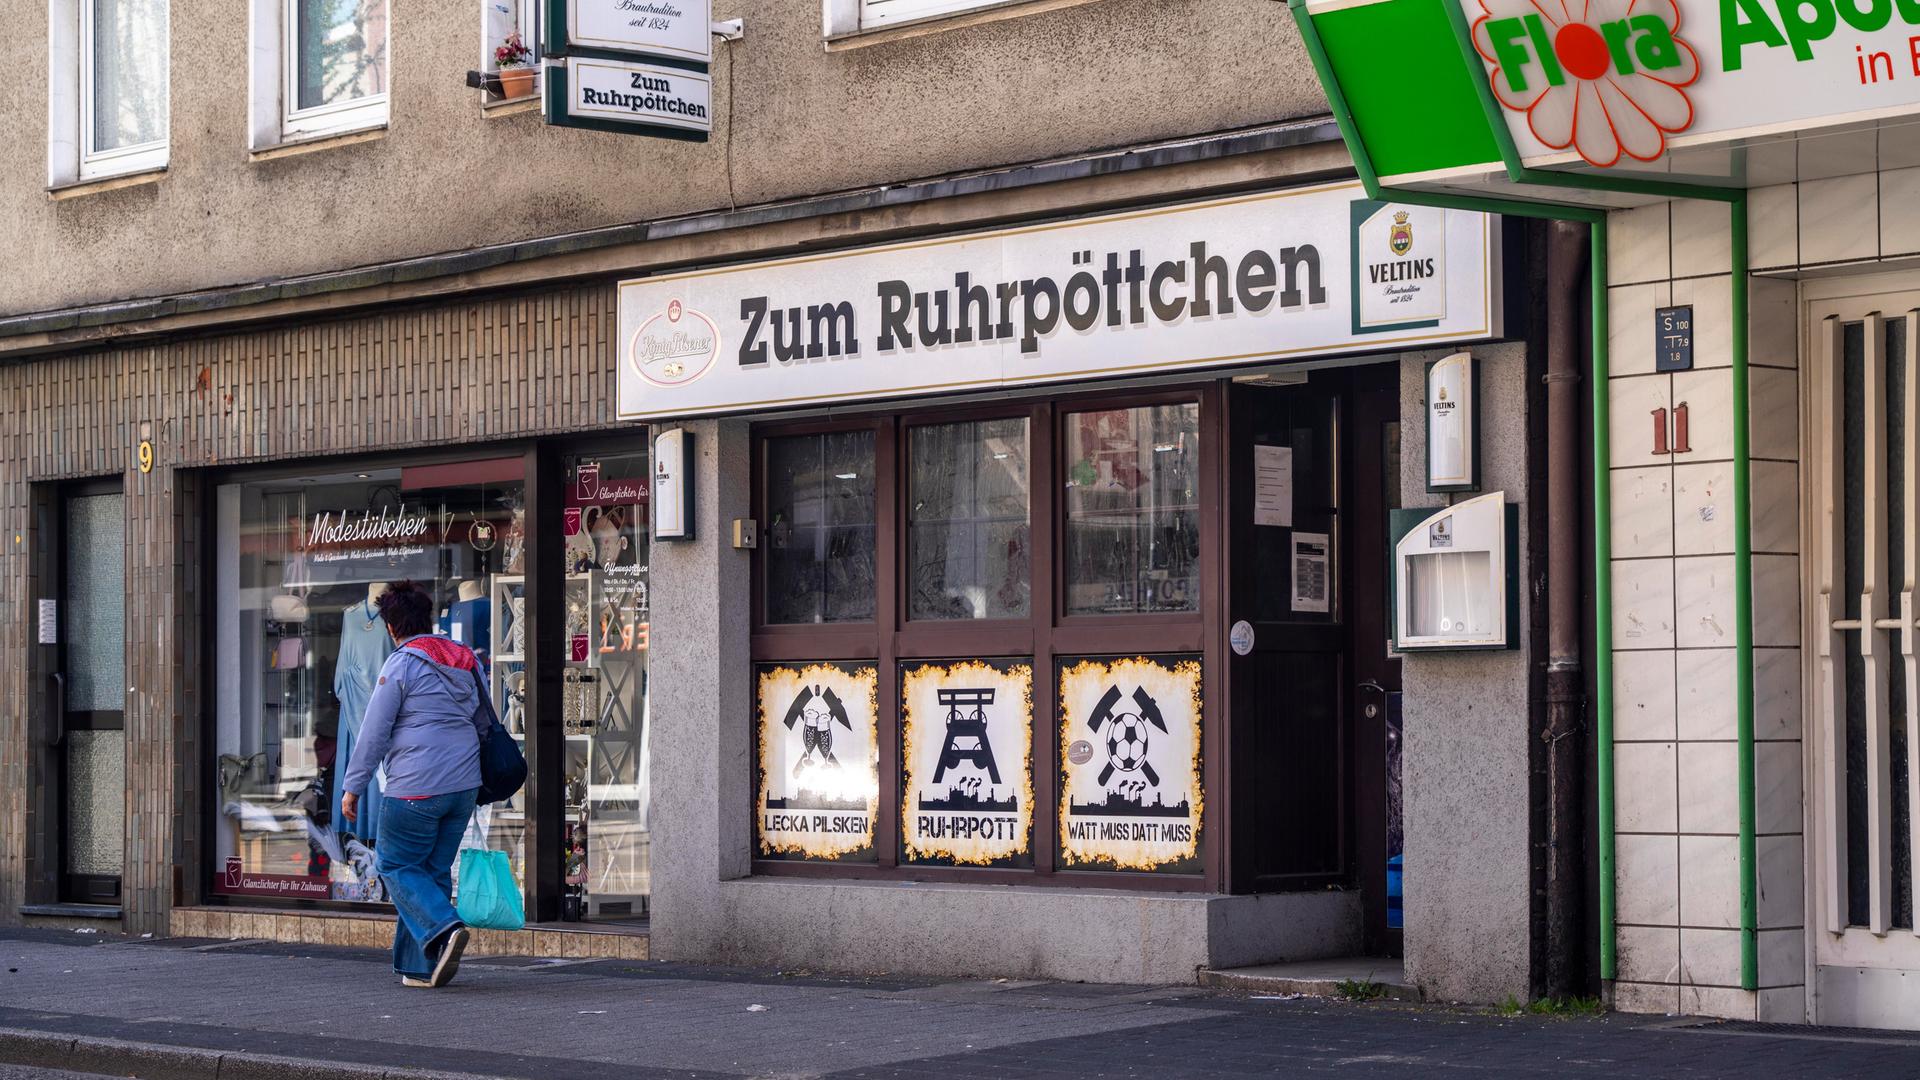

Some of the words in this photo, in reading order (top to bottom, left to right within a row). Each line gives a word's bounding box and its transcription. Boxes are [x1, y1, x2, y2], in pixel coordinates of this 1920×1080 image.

[614, 0, 682, 17] Brautradition
[628, 17, 647, 28] seit
[648, 17, 670, 31] 1824
[1718, 0, 1920, 73] Apo
[1855, 44, 1894, 84] in
[631, 72, 671, 93] Zum
[583, 87, 707, 119] Ruhrpöttchen
[1369, 258, 1435, 284] VELTINS
[738, 295, 860, 370] Zum
[876, 240, 1328, 356] Ruhrpöttchen
[1664, 317, 1673, 331] S
[1676, 320, 1689, 330] 100
[1651, 406, 1693, 455] 11
[139, 441, 153, 473] 9
[599, 485, 637, 502] Glanzlichter
[308, 503, 428, 546] Modestübchen
[764, 815, 810, 833] LECKA
[812, 815, 868, 834] PILSKEN
[917, 816, 1018, 840] RUHRPOTT
[1067, 821, 1098, 841] WATT
[1100, 822, 1130, 841] MUSS
[1131, 823, 1159, 842] DATT
[1161, 823, 1192, 843] MUSS
[243, 878, 279, 891] Glanzlichter
[278, 879, 290, 893] für
[290, 880, 300, 891] Ihr
[300, 881, 328, 893] Zuhause
